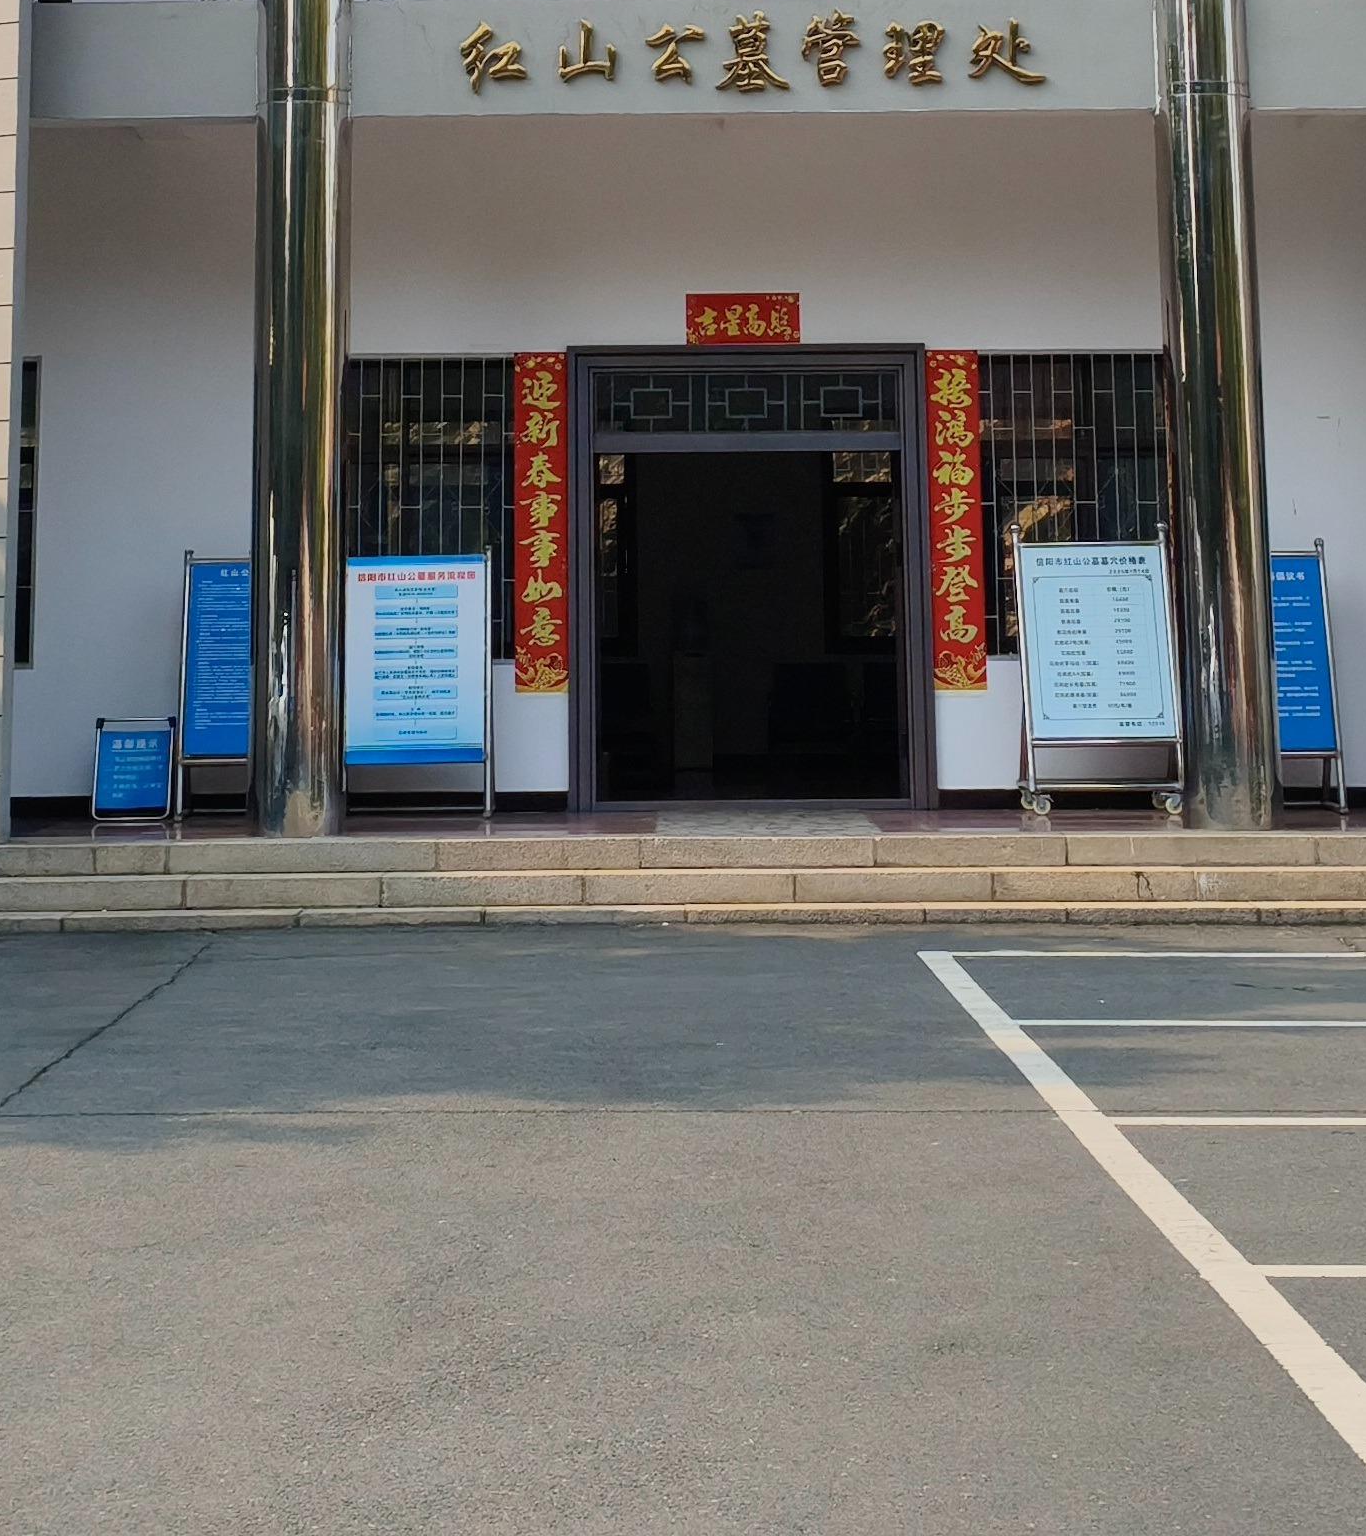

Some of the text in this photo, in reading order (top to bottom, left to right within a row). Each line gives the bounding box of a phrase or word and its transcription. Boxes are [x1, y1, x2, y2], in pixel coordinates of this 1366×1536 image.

[458, 8, 1046, 95] 红山公墓管理处
[693, 302, 792, 339] 吉星高照
[518, 370, 565, 648] 迎新春事事如意
[931, 368, 980, 645] 接鸿福步步登高
